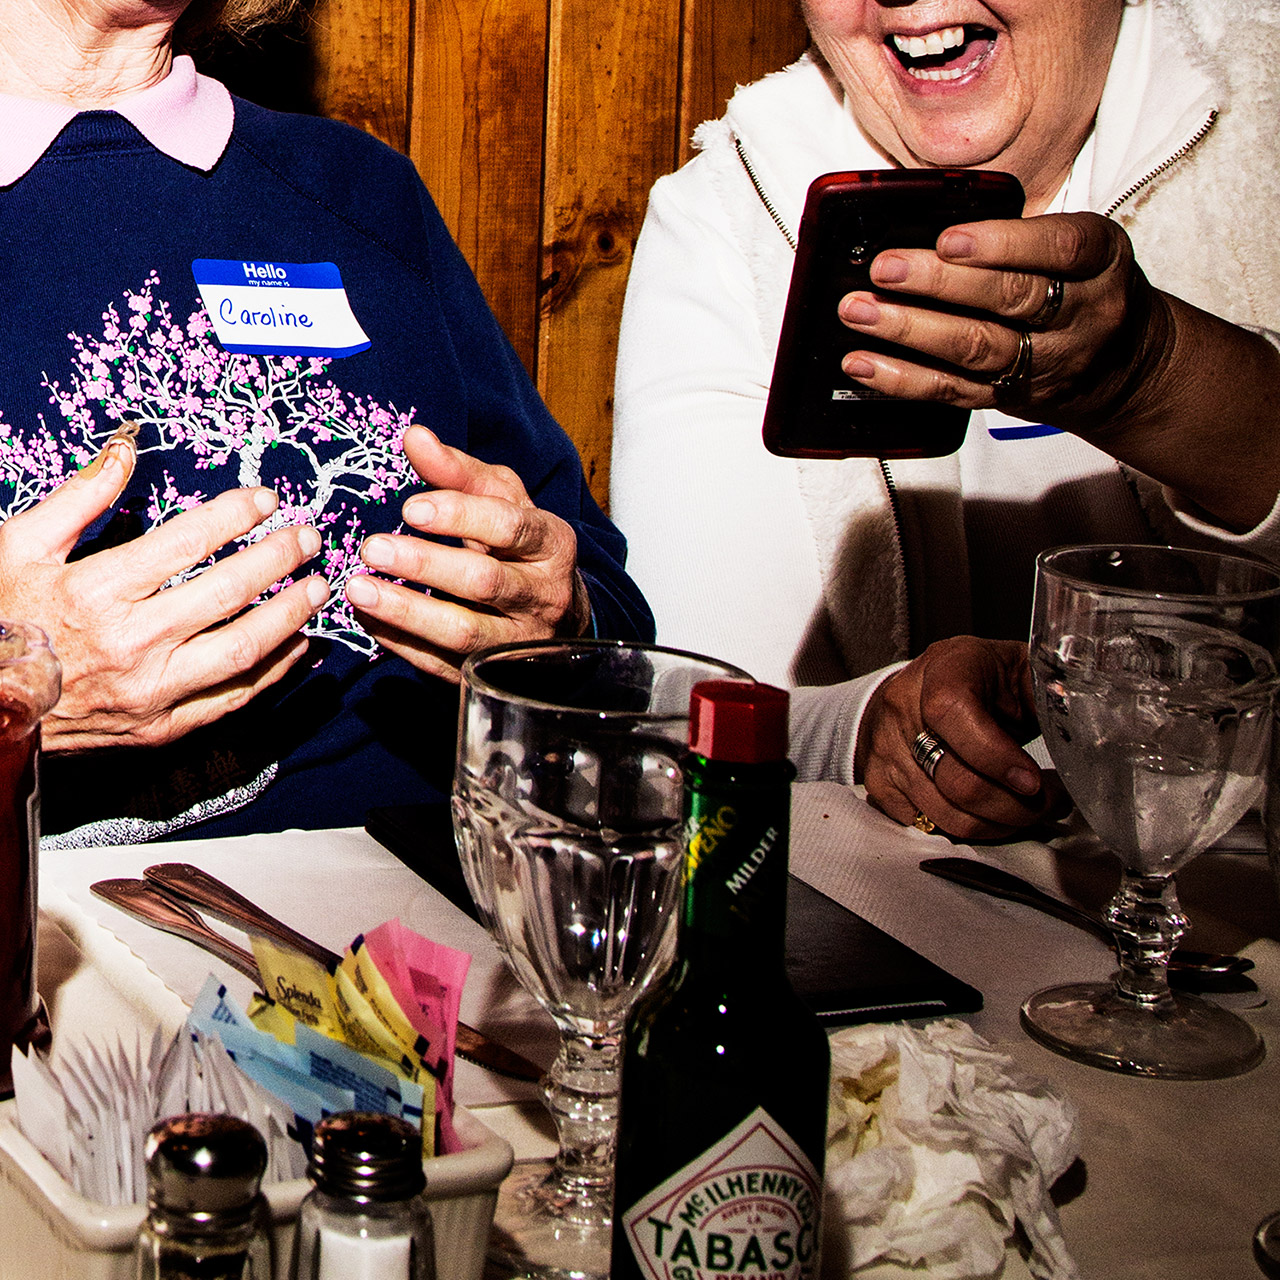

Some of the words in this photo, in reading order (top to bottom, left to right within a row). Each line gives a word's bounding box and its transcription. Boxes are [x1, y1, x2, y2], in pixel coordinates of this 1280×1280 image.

[242, 262, 287, 280] Hello
[248, 279, 261, 288] my
[261, 279, 283, 287] name
[283, 279, 291, 287] is
[219, 297, 314, 328] Caroline
[725, 826, 779, 896] MILDER
